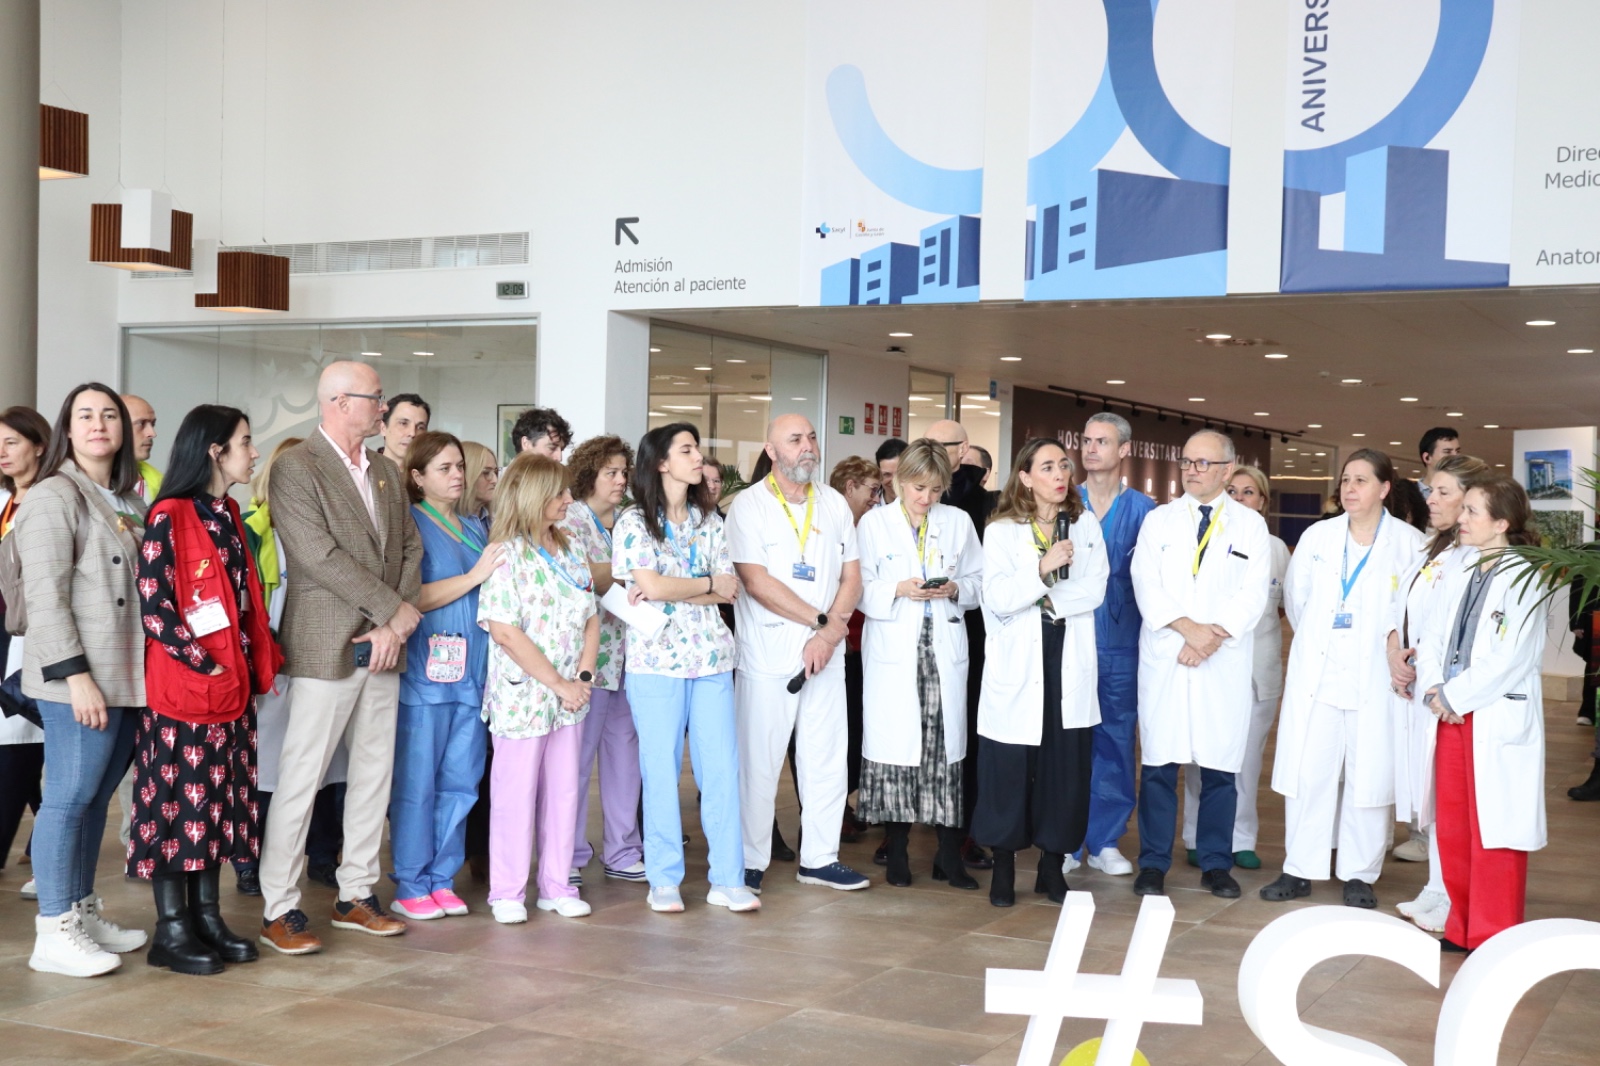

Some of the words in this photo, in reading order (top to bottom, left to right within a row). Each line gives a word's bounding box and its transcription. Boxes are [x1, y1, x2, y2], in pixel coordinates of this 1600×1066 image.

[1556, 145, 1600, 163] Dire
[614, 256, 673, 273] Admisión
[1536, 248, 1600, 266] Anato
[502, 284, 524, 295] 12:09
[613, 277, 670, 294] Atención
[673, 277, 685, 292] al
[689, 276, 747, 294] paciente
